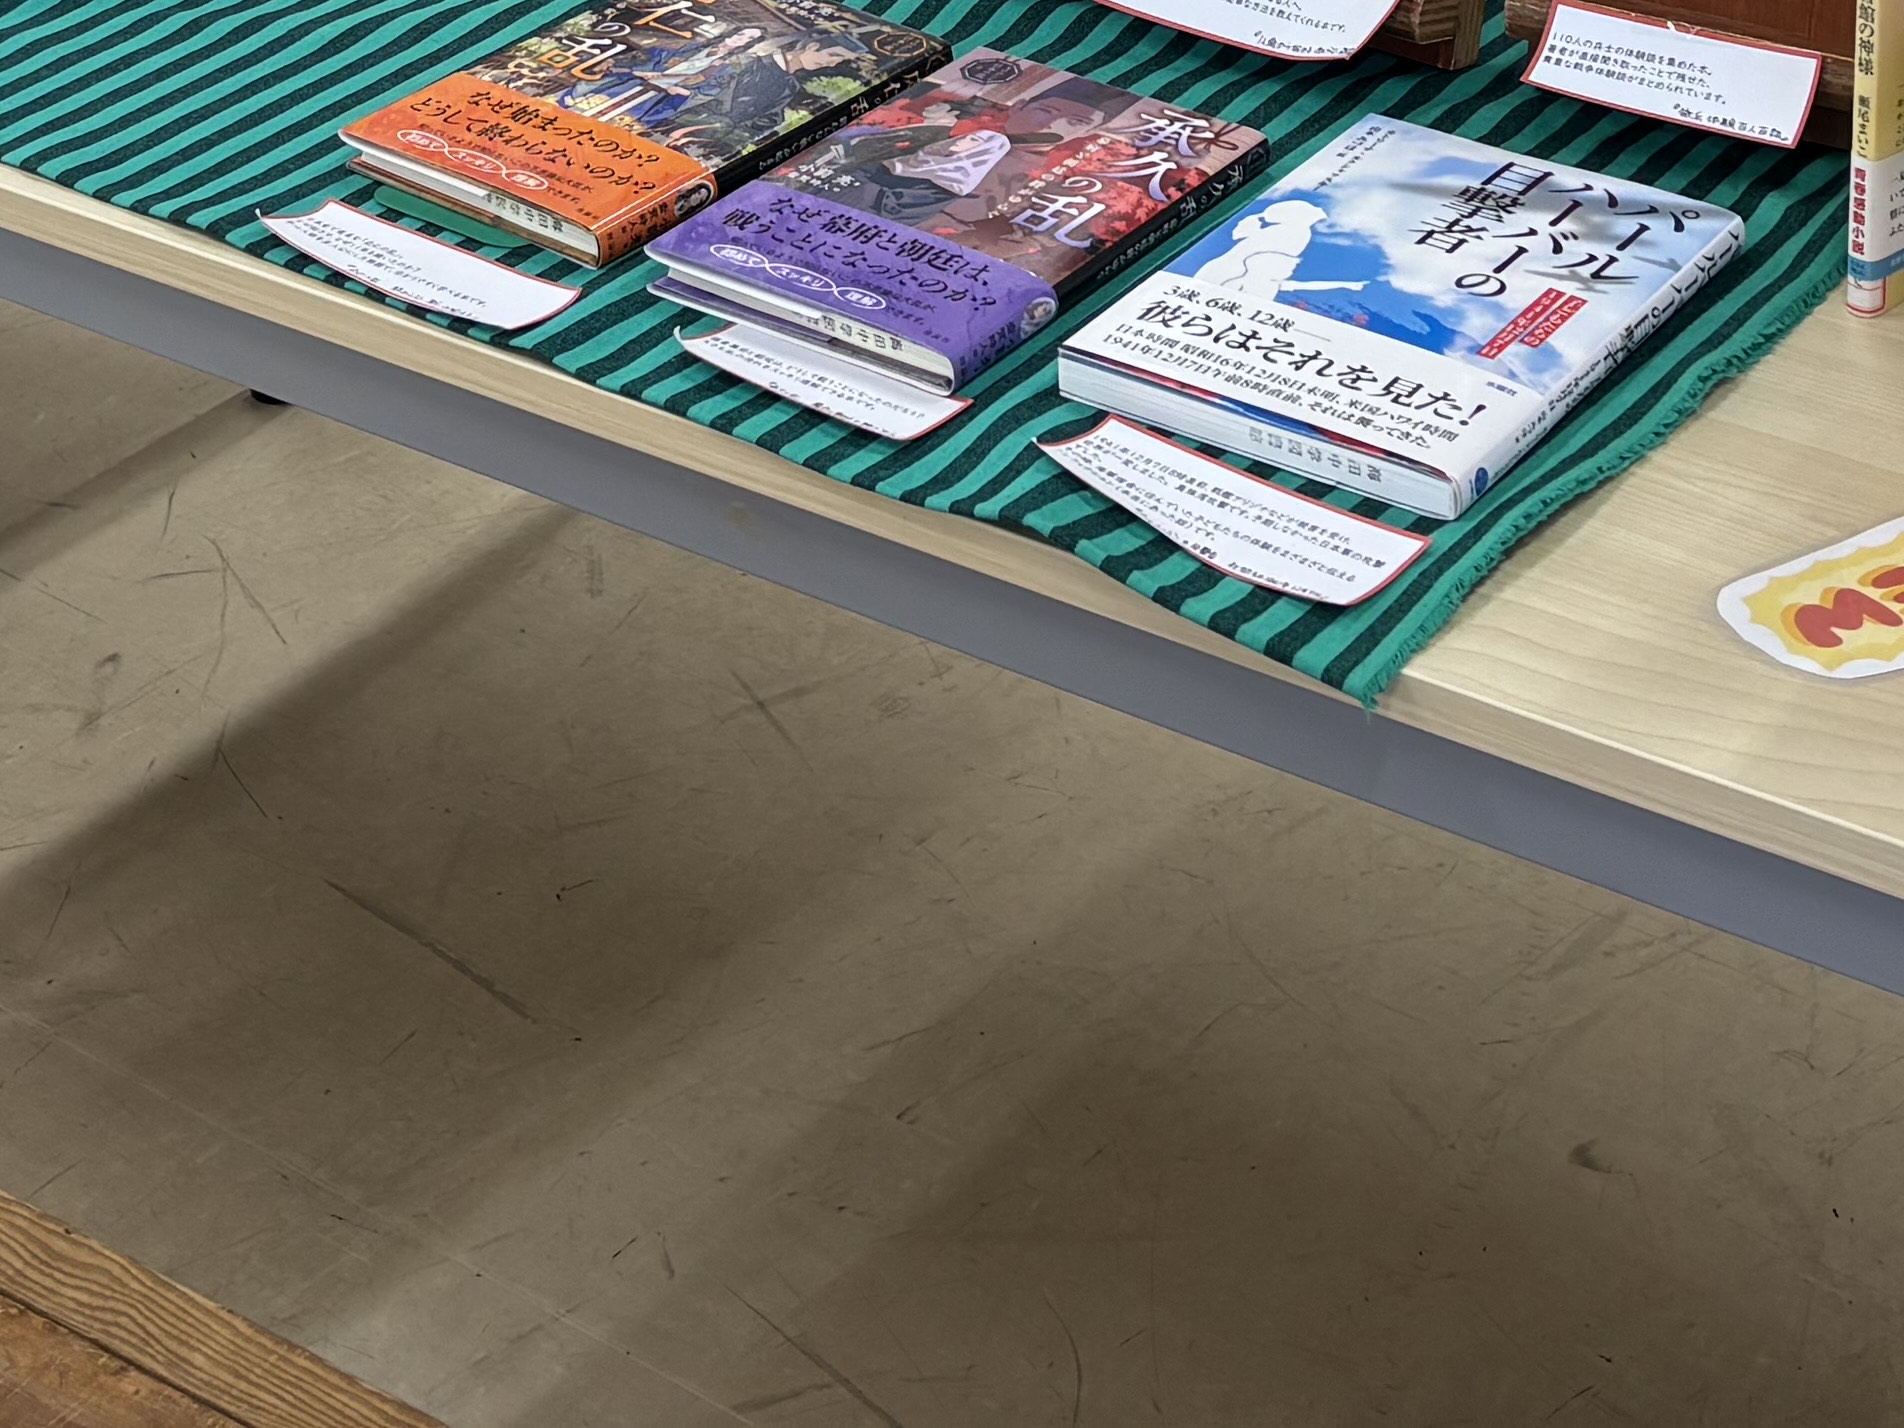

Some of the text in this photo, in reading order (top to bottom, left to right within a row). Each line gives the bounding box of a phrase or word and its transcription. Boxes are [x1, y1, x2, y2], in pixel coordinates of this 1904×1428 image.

[409, 96, 657, 196] どうして終わらないのか?
[467, 90, 661, 168] なぜ始まったのか?
[1024, 106, 1202, 252] 承久の乱
[767, 194, 990, 285] なぜ幕府と朝廷は、
[1413, 159, 1556, 255] 目撃者
[721, 207, 998, 314] 戦うことになったのか?
[1136, 298, 1488, 430] 彼らはそれを見た!
